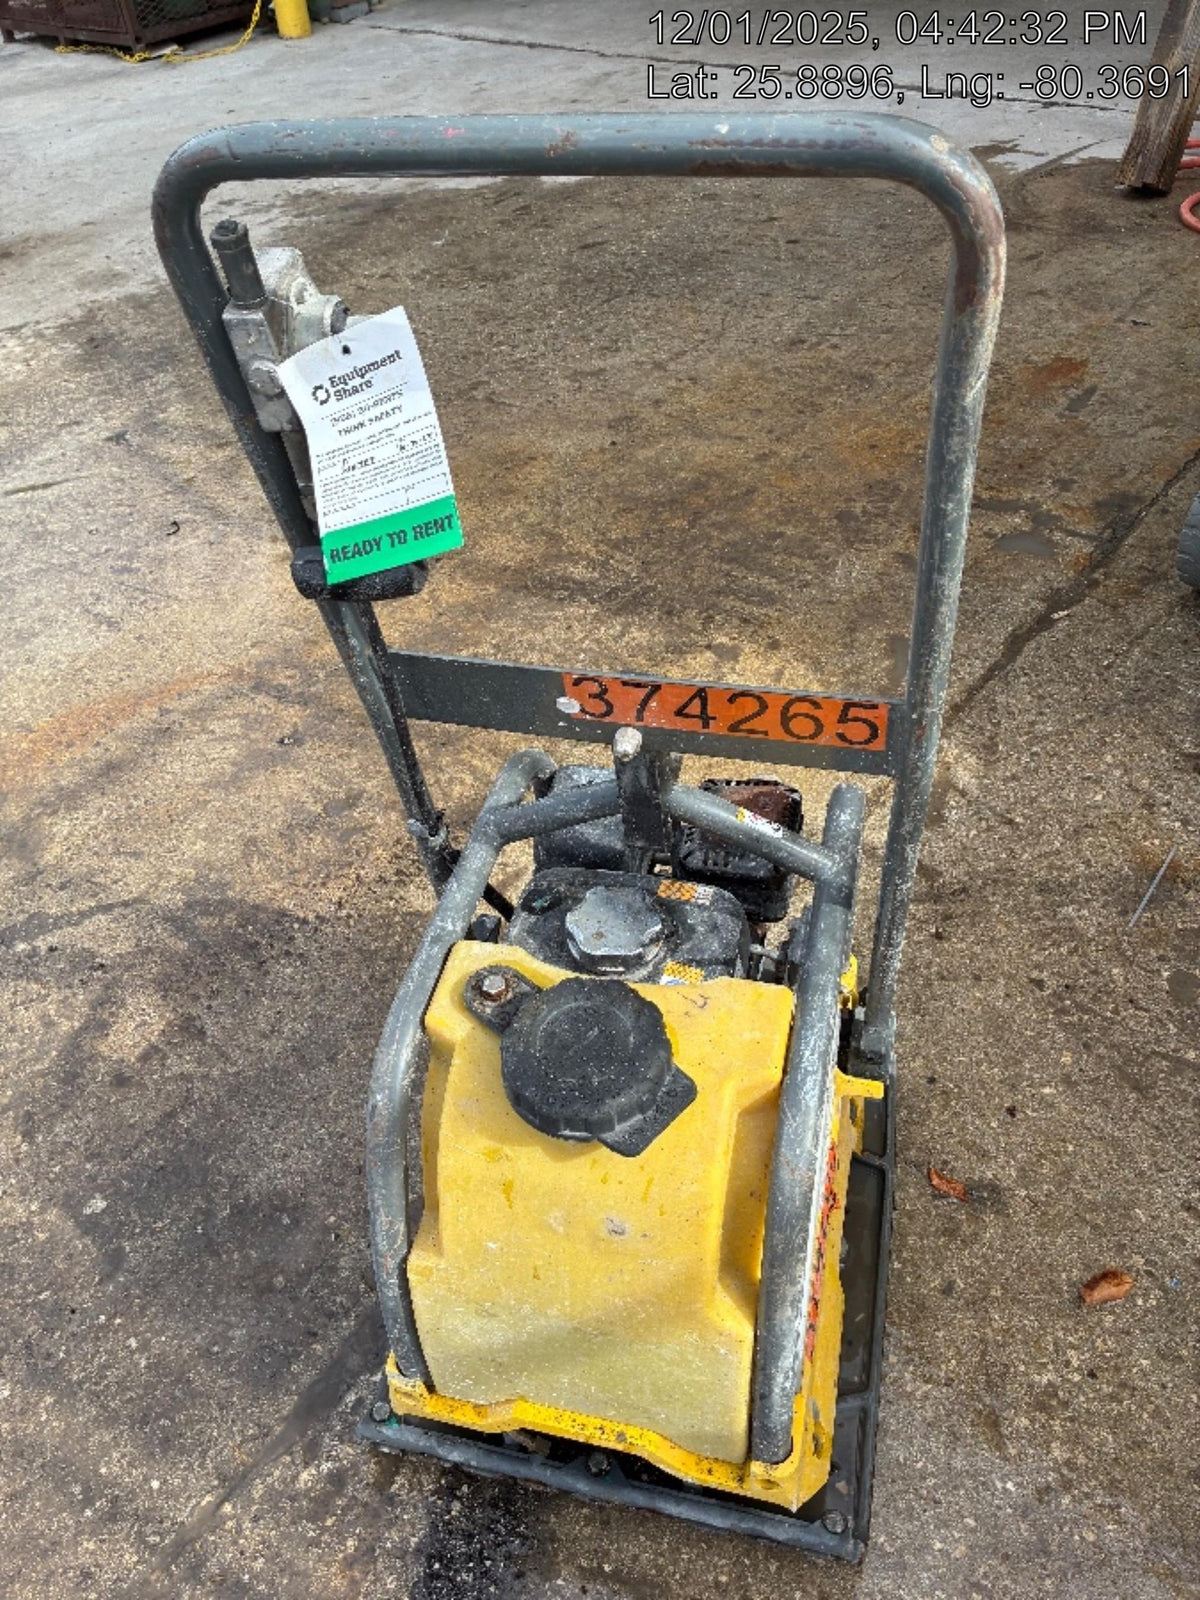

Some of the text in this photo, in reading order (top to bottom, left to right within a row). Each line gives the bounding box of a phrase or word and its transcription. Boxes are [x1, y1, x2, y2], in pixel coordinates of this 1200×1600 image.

[328, 350, 402, 388] Equipment
[329, 514, 455, 564] READY TO RENT
[571, 676, 880, 746] 374265
